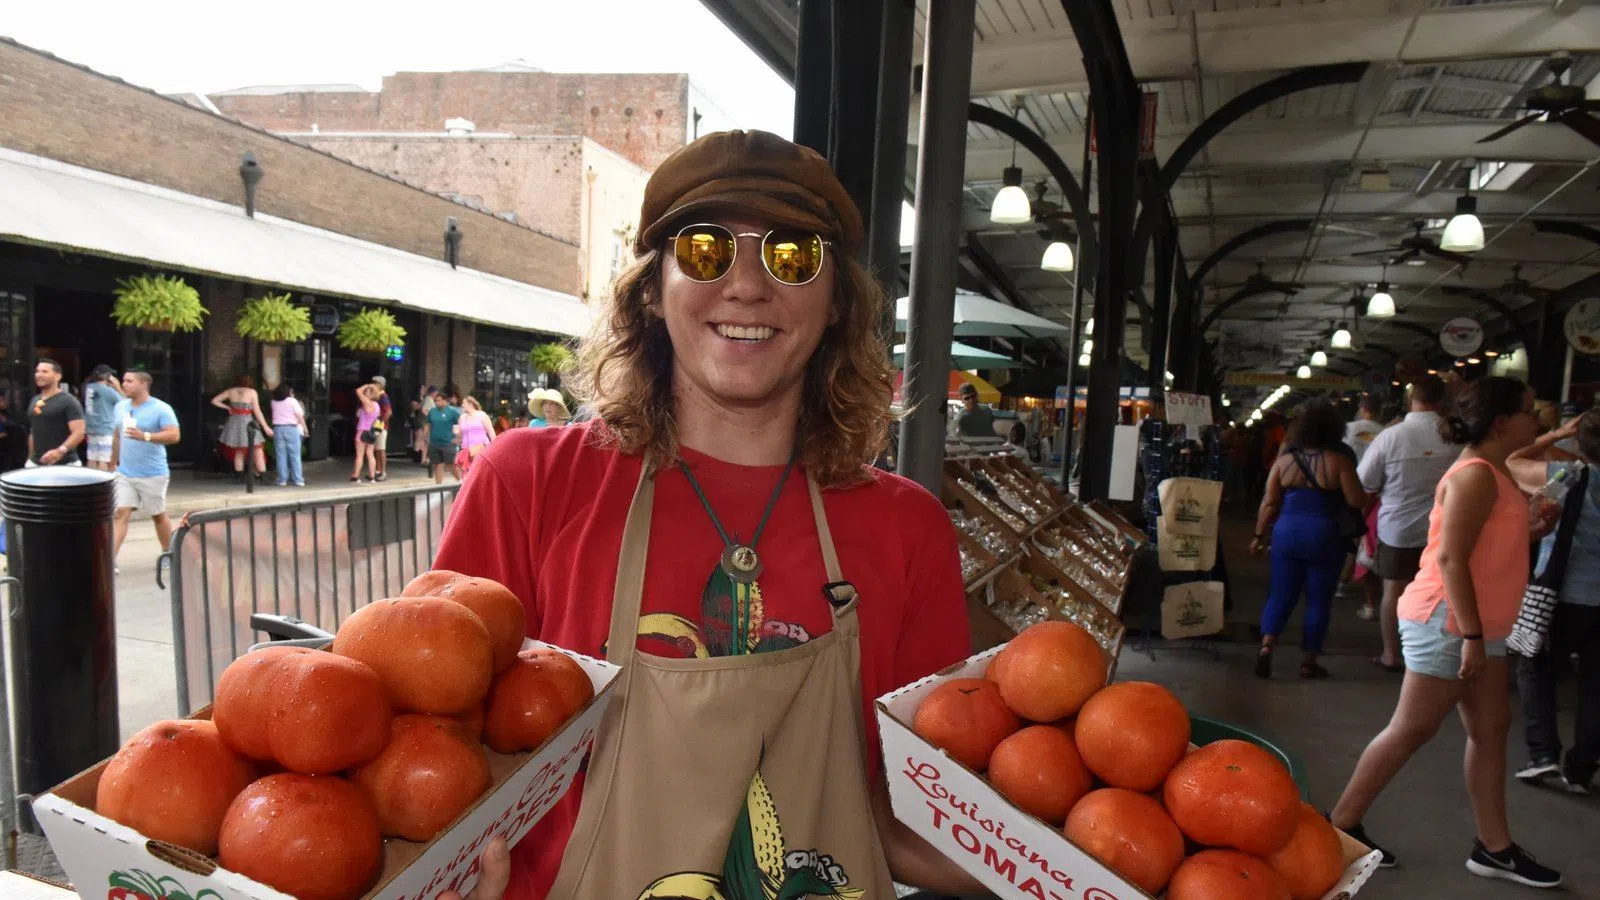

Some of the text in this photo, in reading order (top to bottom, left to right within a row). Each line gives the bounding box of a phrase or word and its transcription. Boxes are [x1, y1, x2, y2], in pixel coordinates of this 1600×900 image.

[397, 728, 594, 900] uisiana Creole
[903, 757, 1075, 892] Louisiana
[926, 800, 1063, 900] TOMA
